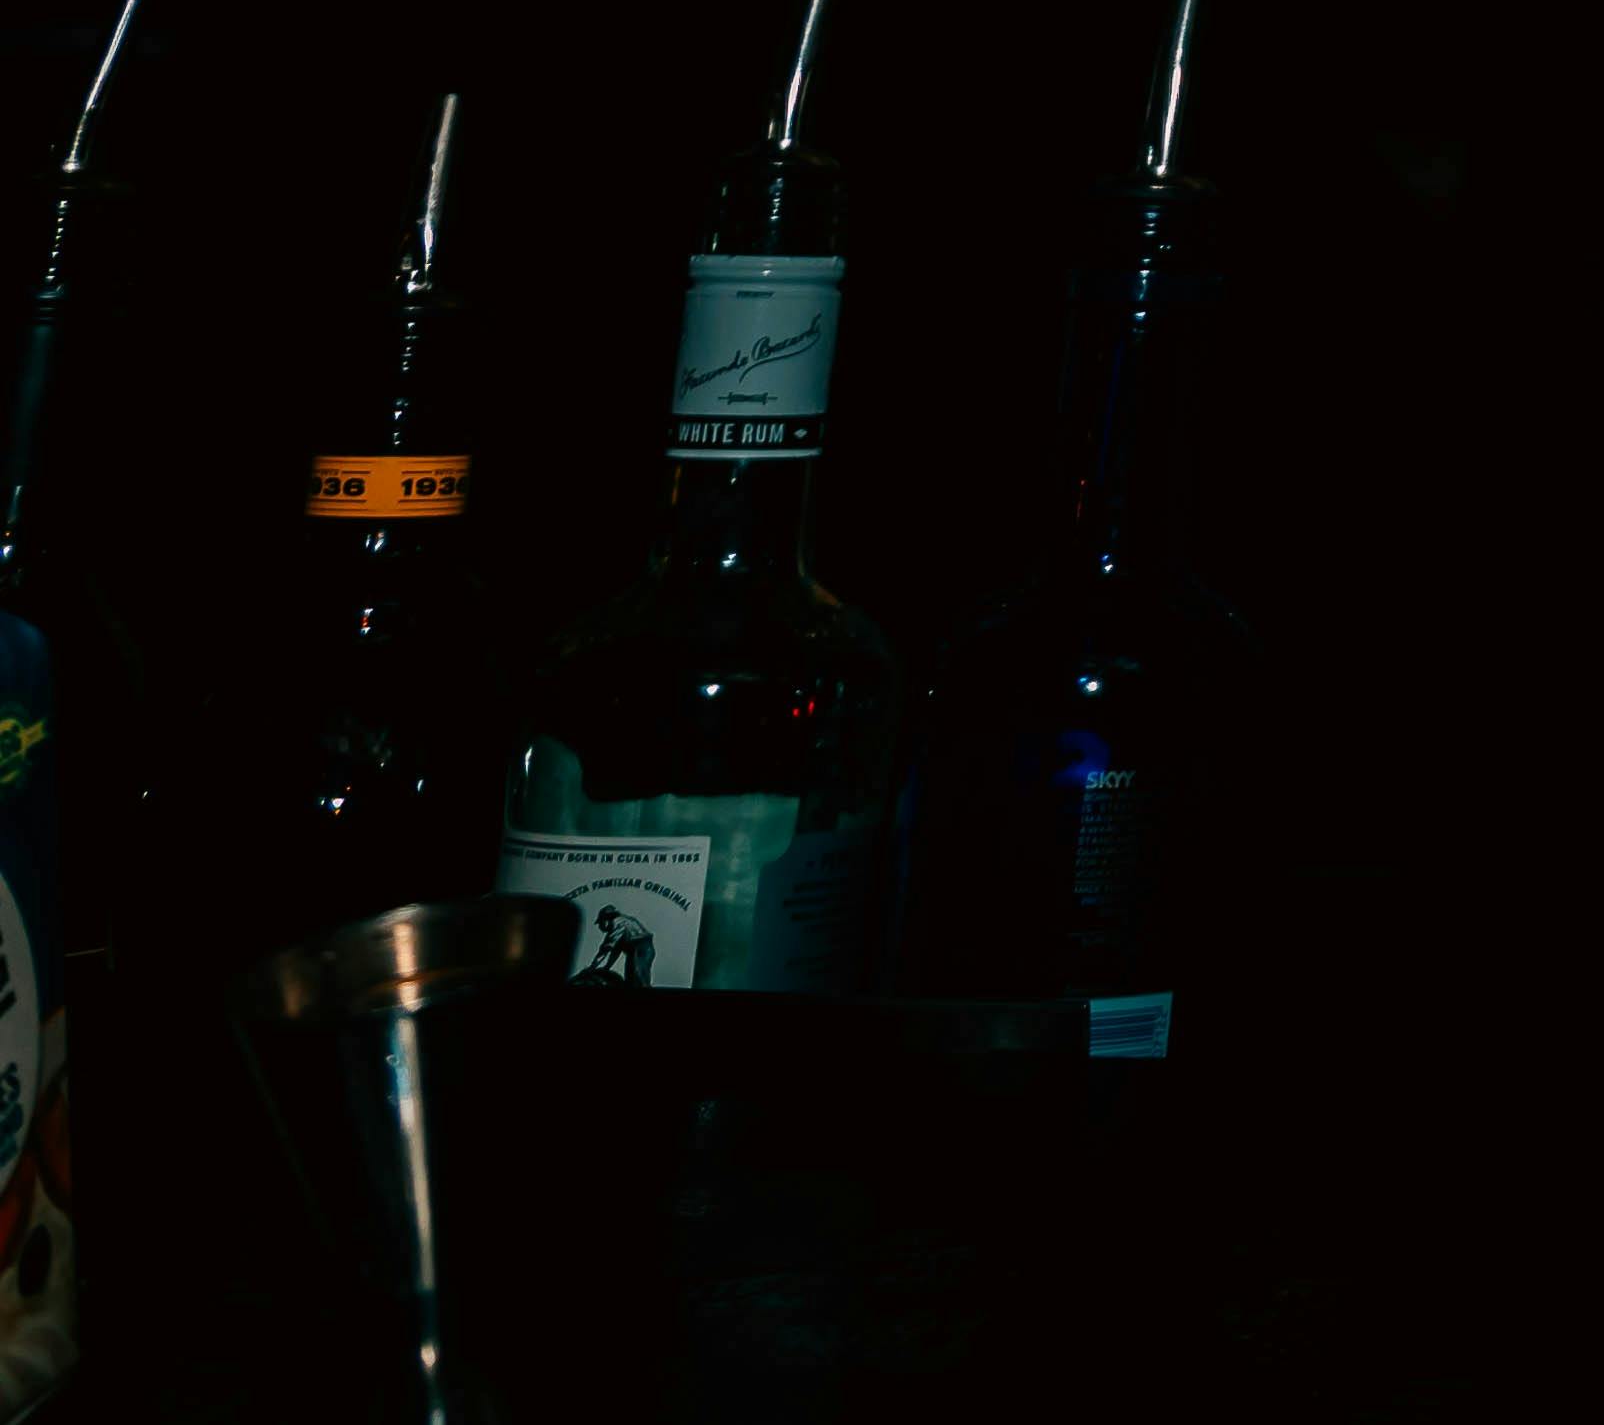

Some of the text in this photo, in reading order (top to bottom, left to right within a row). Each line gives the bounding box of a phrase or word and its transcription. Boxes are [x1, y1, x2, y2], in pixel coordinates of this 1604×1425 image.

[678, 422, 785, 444] WHITE RUM
[1085, 769, 1136, 789] SKYY
[567, 852, 597, 863] BORN
[601, 853, 613, 864] IN
[617, 853, 649, 863] CUBA
[653, 853, 667, 863] IN
[592, 877, 642, 891] FAMILIAR
[644, 880, 692, 912] ORIGINAL
